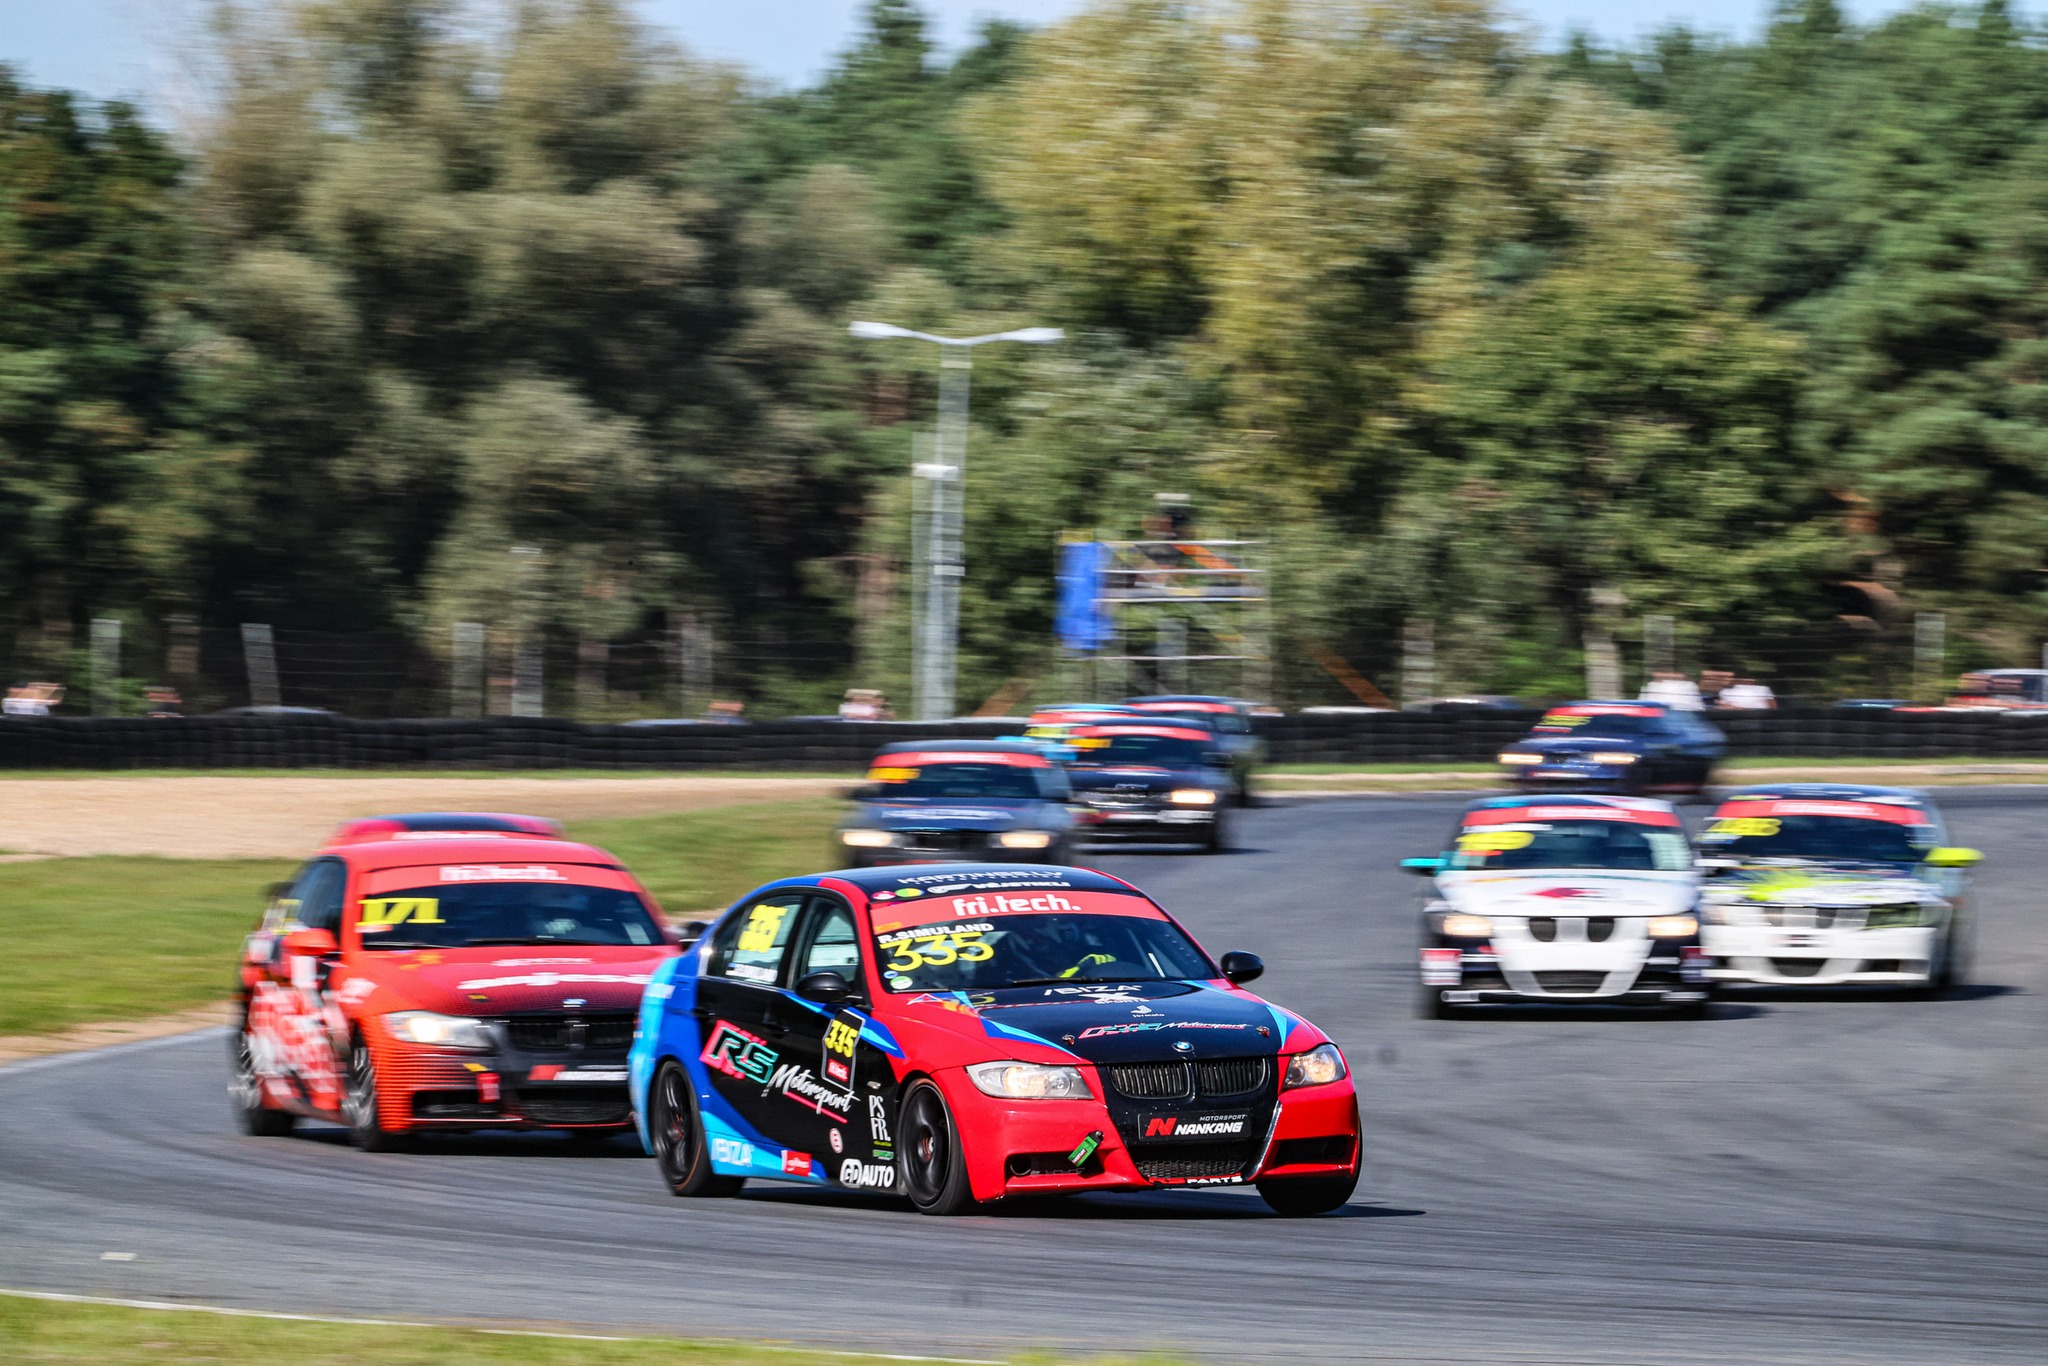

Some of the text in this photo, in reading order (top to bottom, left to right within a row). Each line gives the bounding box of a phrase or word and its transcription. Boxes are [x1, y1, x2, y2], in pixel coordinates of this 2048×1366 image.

[952, 894, 1082, 917] fri.tech.
[877, 923, 995, 944] R.SIMULAND
[879, 931, 995, 972] 335
[824, 1019, 859, 1058] 335
[711, 1026, 861, 1115] RS Motorsport
[868, 1094, 885, 1119] PS
[1174, 1121, 1244, 1136] NANKANG
[861, 1165, 895, 1188] AUTO
[1186, 1175, 1243, 1184] PARTS
